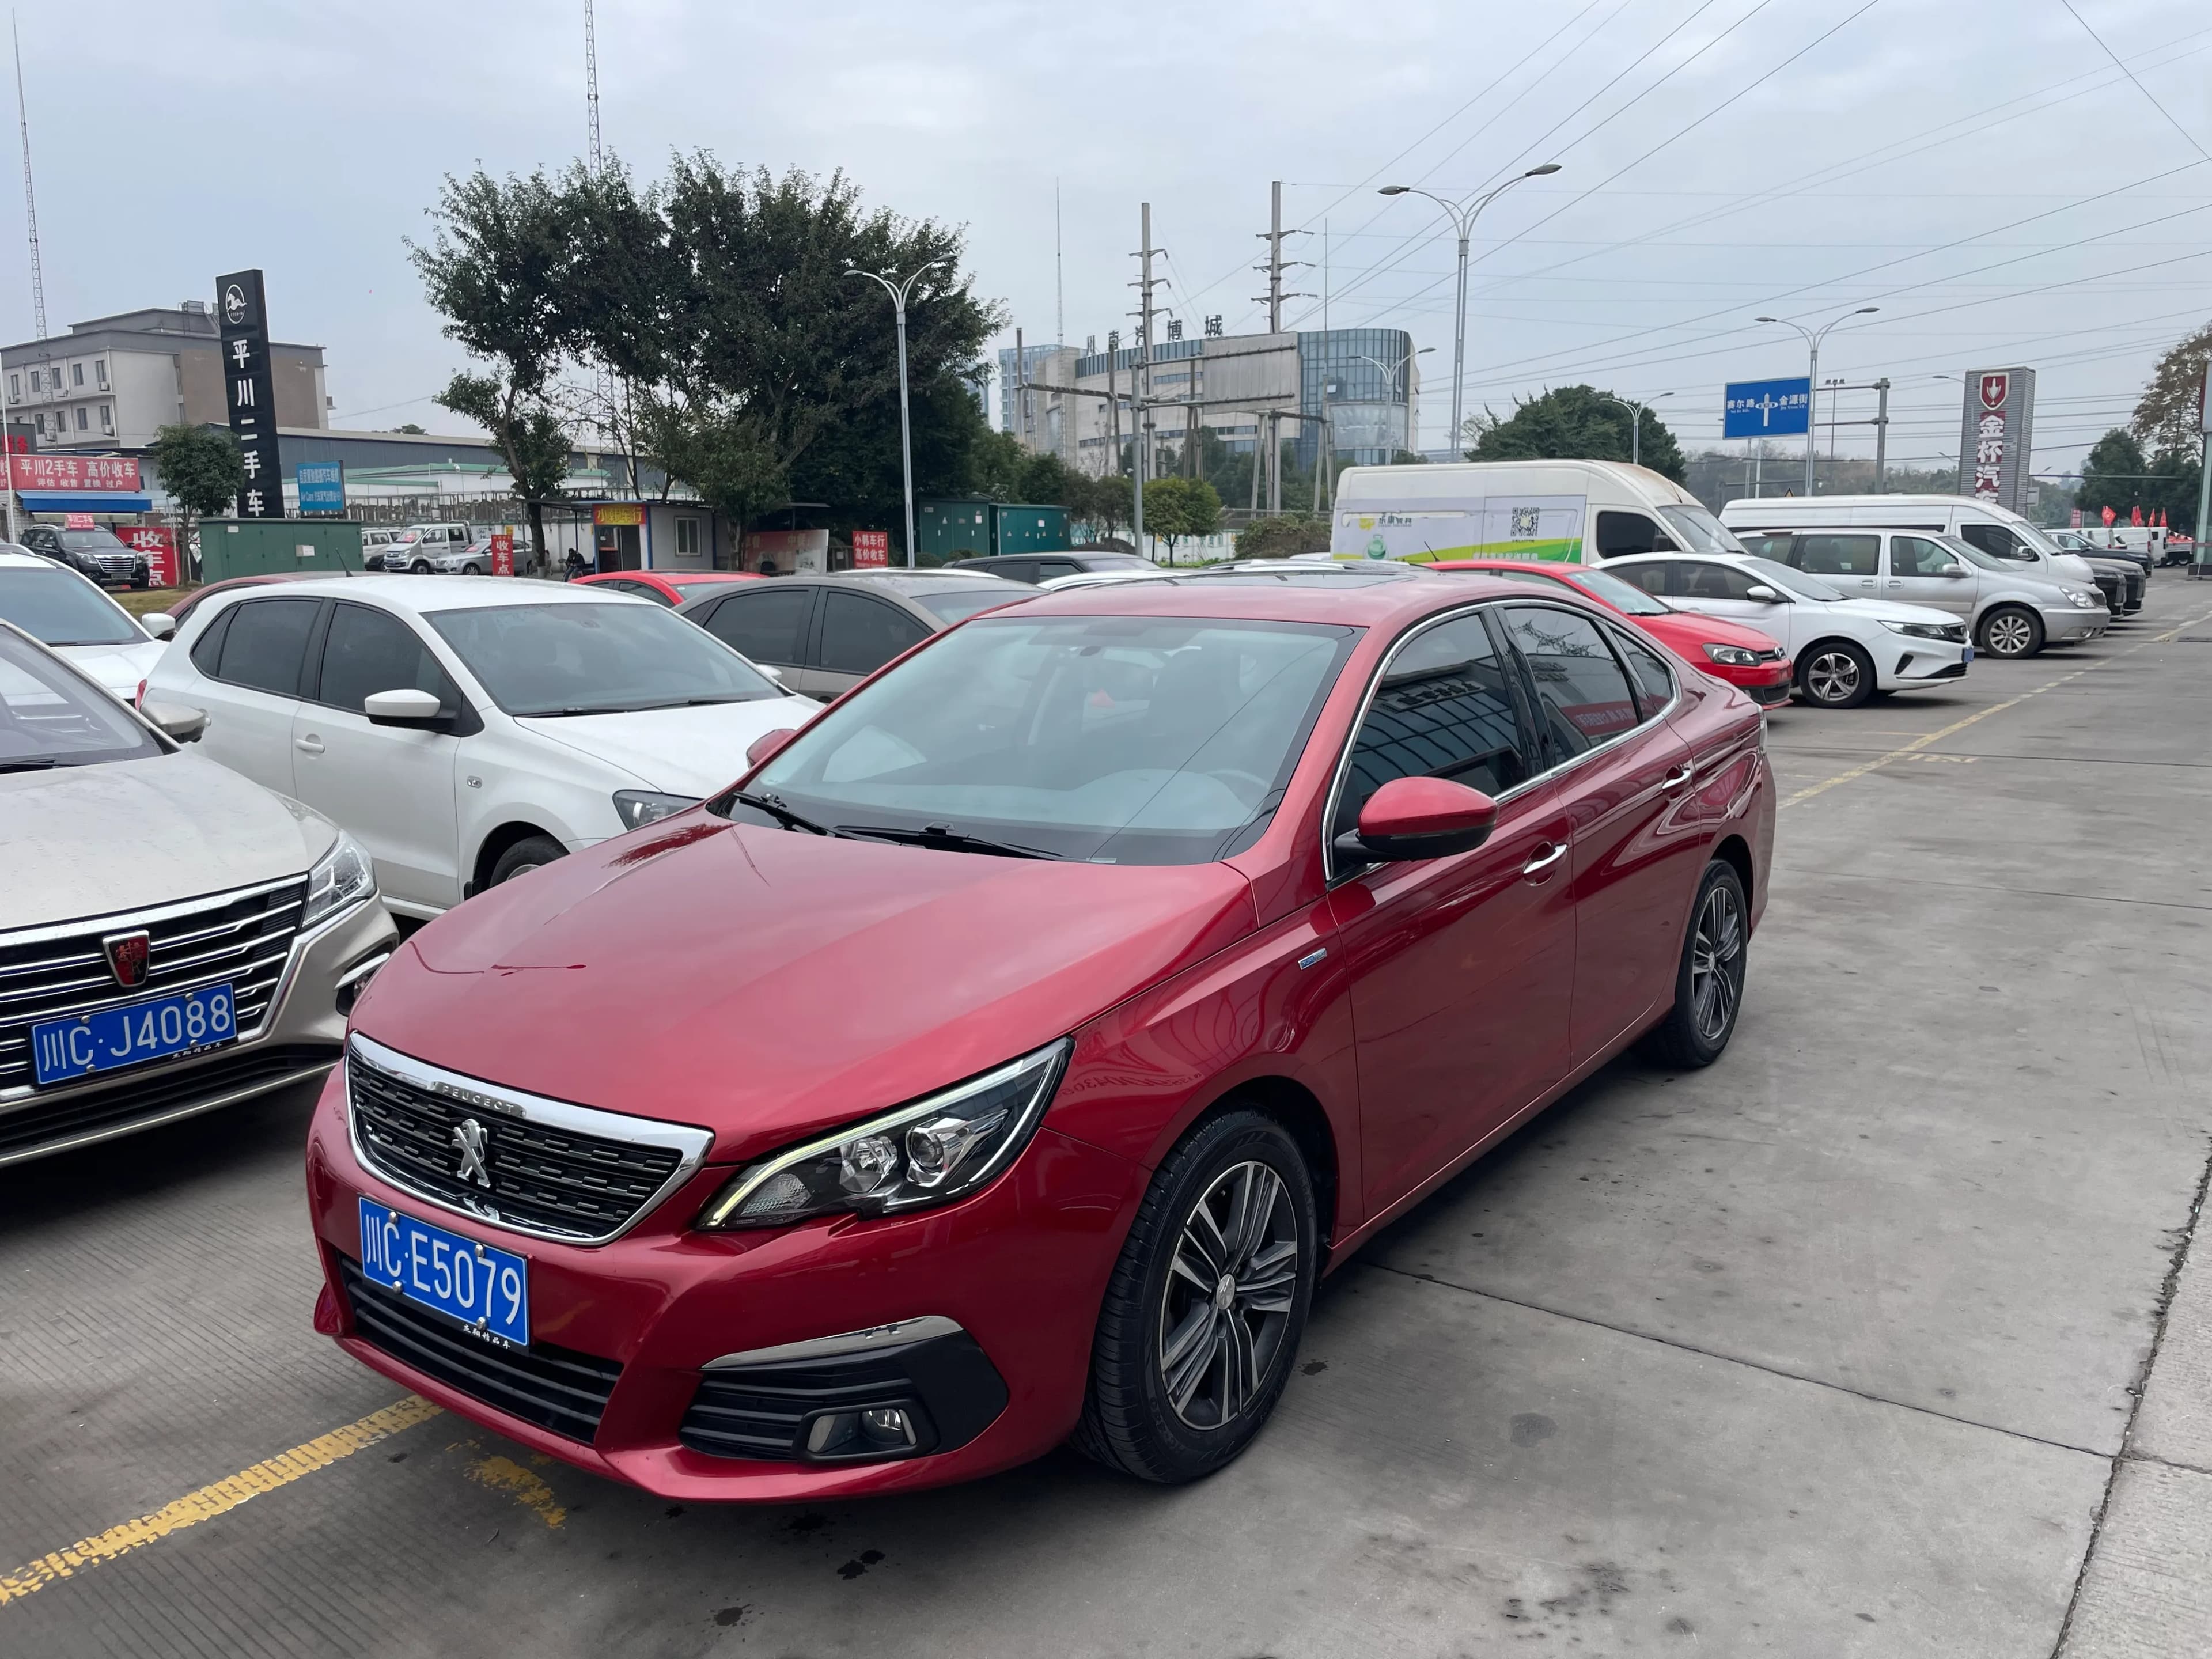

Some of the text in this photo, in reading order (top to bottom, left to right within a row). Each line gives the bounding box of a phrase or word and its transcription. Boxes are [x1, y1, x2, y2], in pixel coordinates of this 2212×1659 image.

[233, 339, 265, 517] 平川二手车
[21, 459, 78, 477] 平川2手车
[86, 460, 136, 478] 高价收车
[37, 478, 55, 487] 评估
[106, 479, 123, 488] 过户
[497, 540, 510, 575] 收车点
[854, 548, 885, 562] 高价收车
[442, 1085, 514, 1113] PEUGEOT
